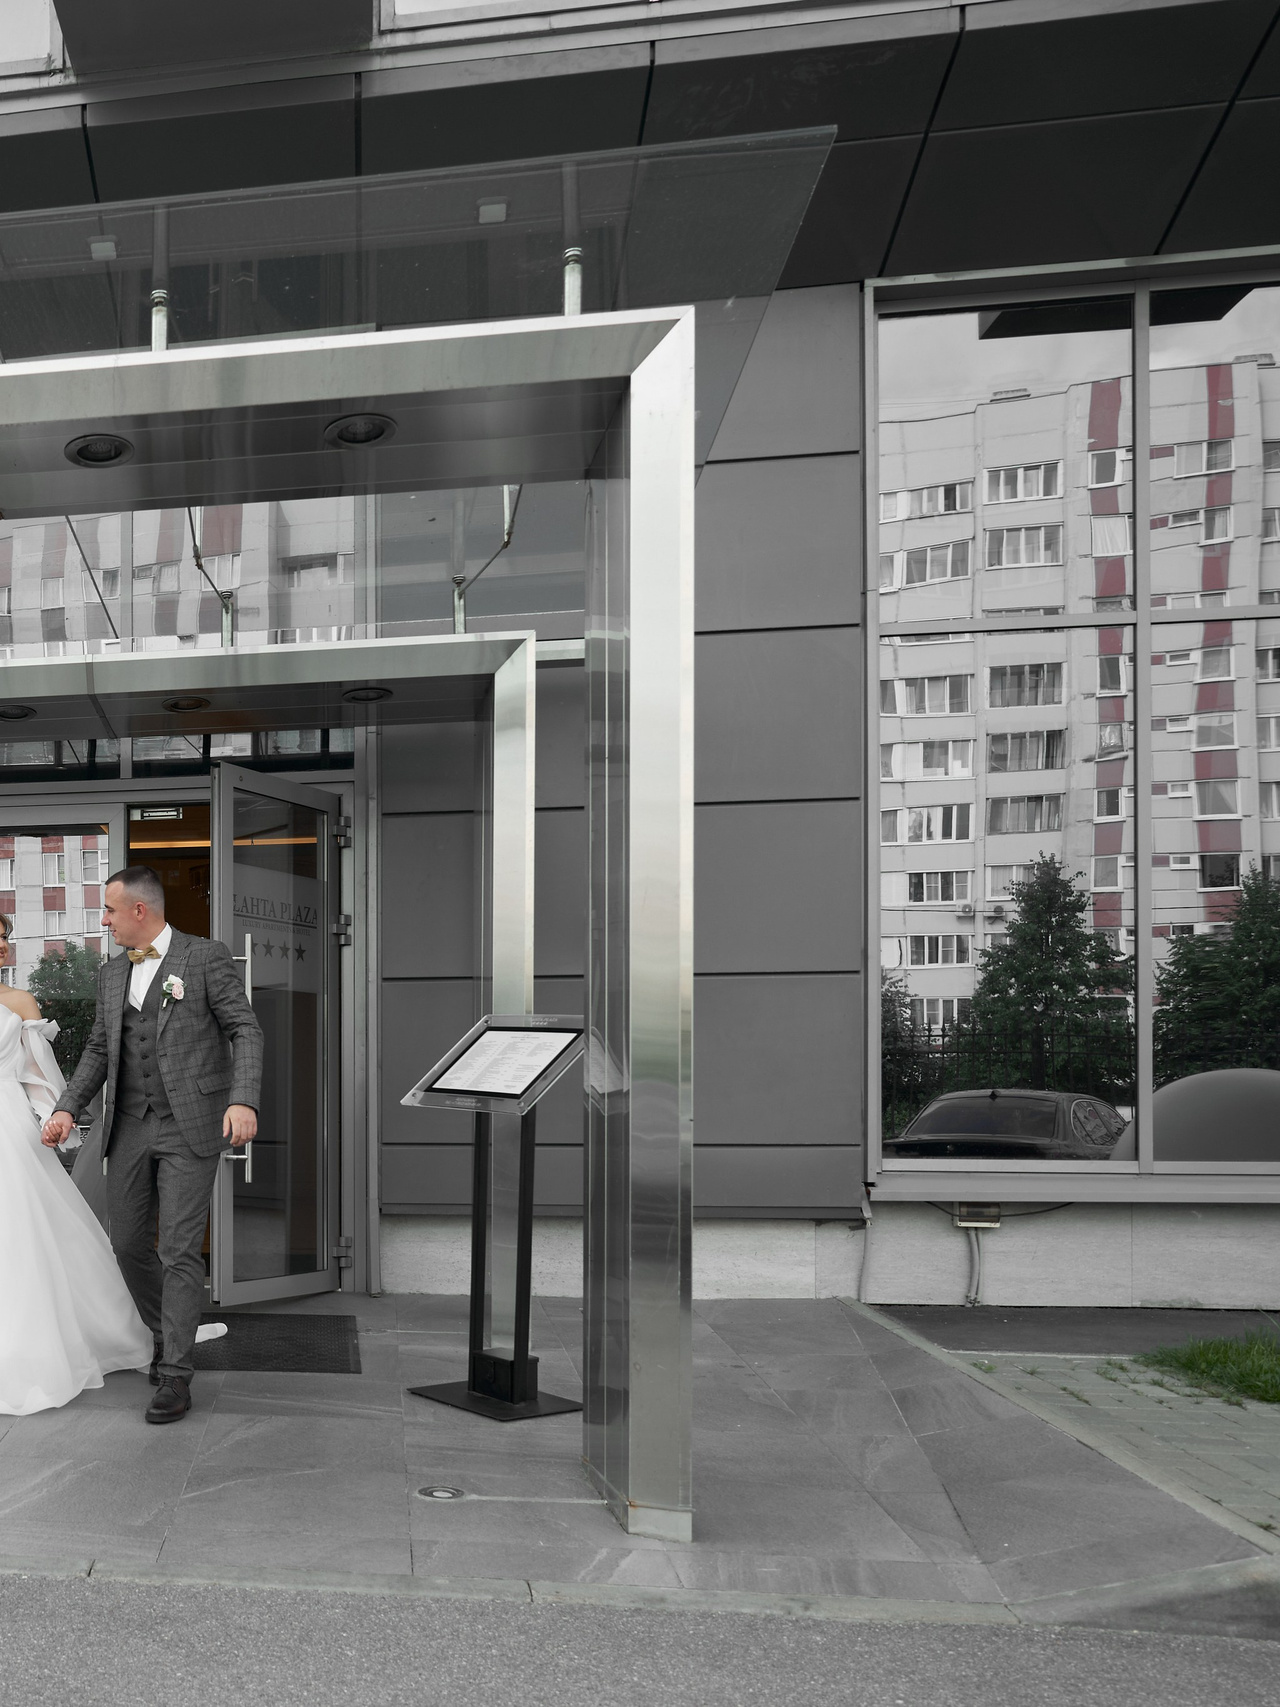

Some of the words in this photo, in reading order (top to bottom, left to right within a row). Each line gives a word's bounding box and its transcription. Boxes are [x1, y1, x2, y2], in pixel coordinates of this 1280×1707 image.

[233, 893, 277, 918] LAHTA
[280, 901, 318, 925] PLAZA
[242, 919, 262, 928] LUXURY
[262, 922, 292, 933] APARTMENTS
[296, 927, 311, 936] HOTEL
